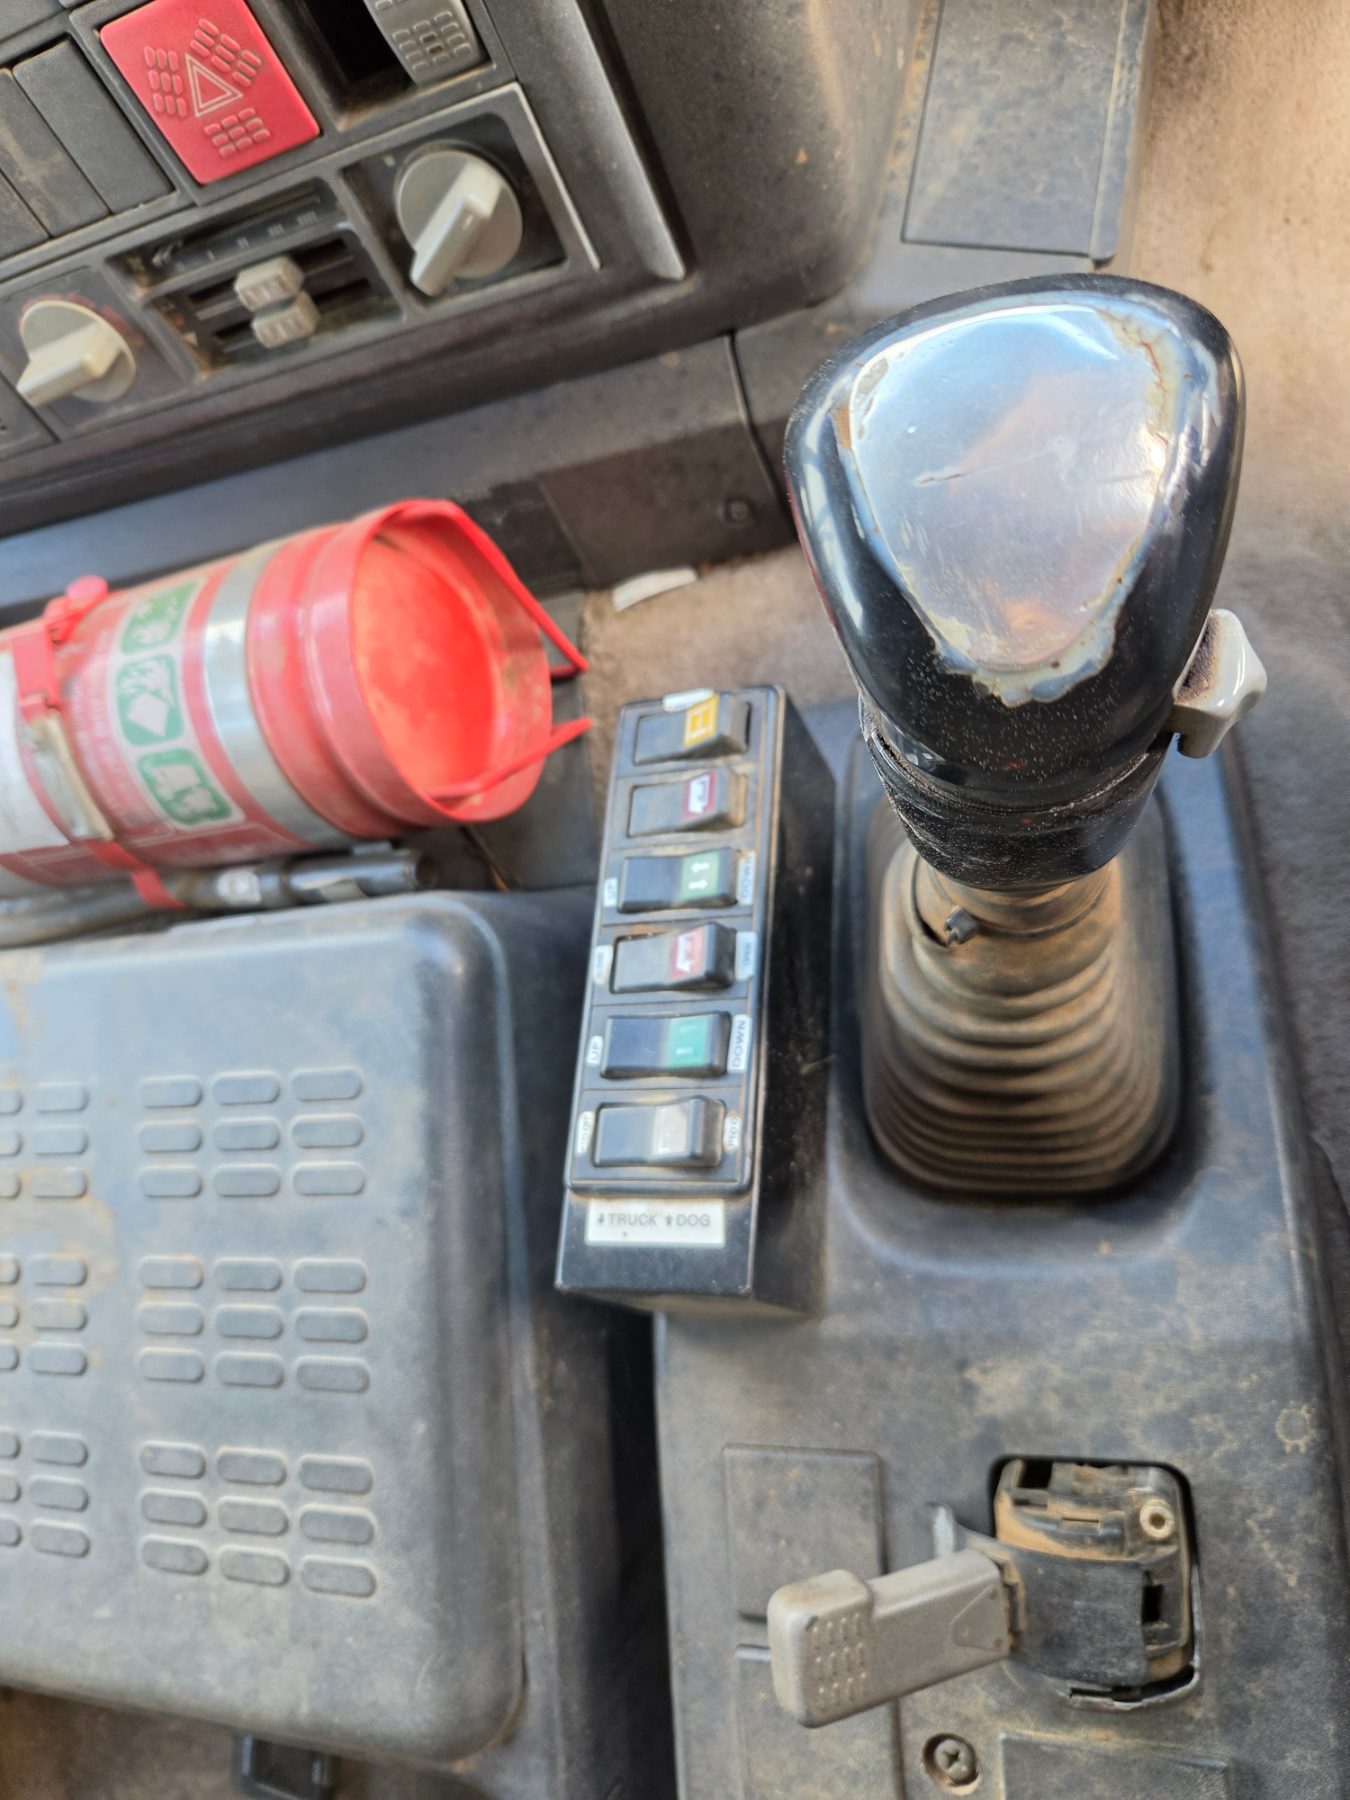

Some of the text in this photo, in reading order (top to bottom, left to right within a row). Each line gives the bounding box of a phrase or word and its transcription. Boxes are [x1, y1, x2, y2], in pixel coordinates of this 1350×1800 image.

[731, 1018, 747, 1069] DOWN
[608, 1212, 712, 1228] TRUCK DOG
